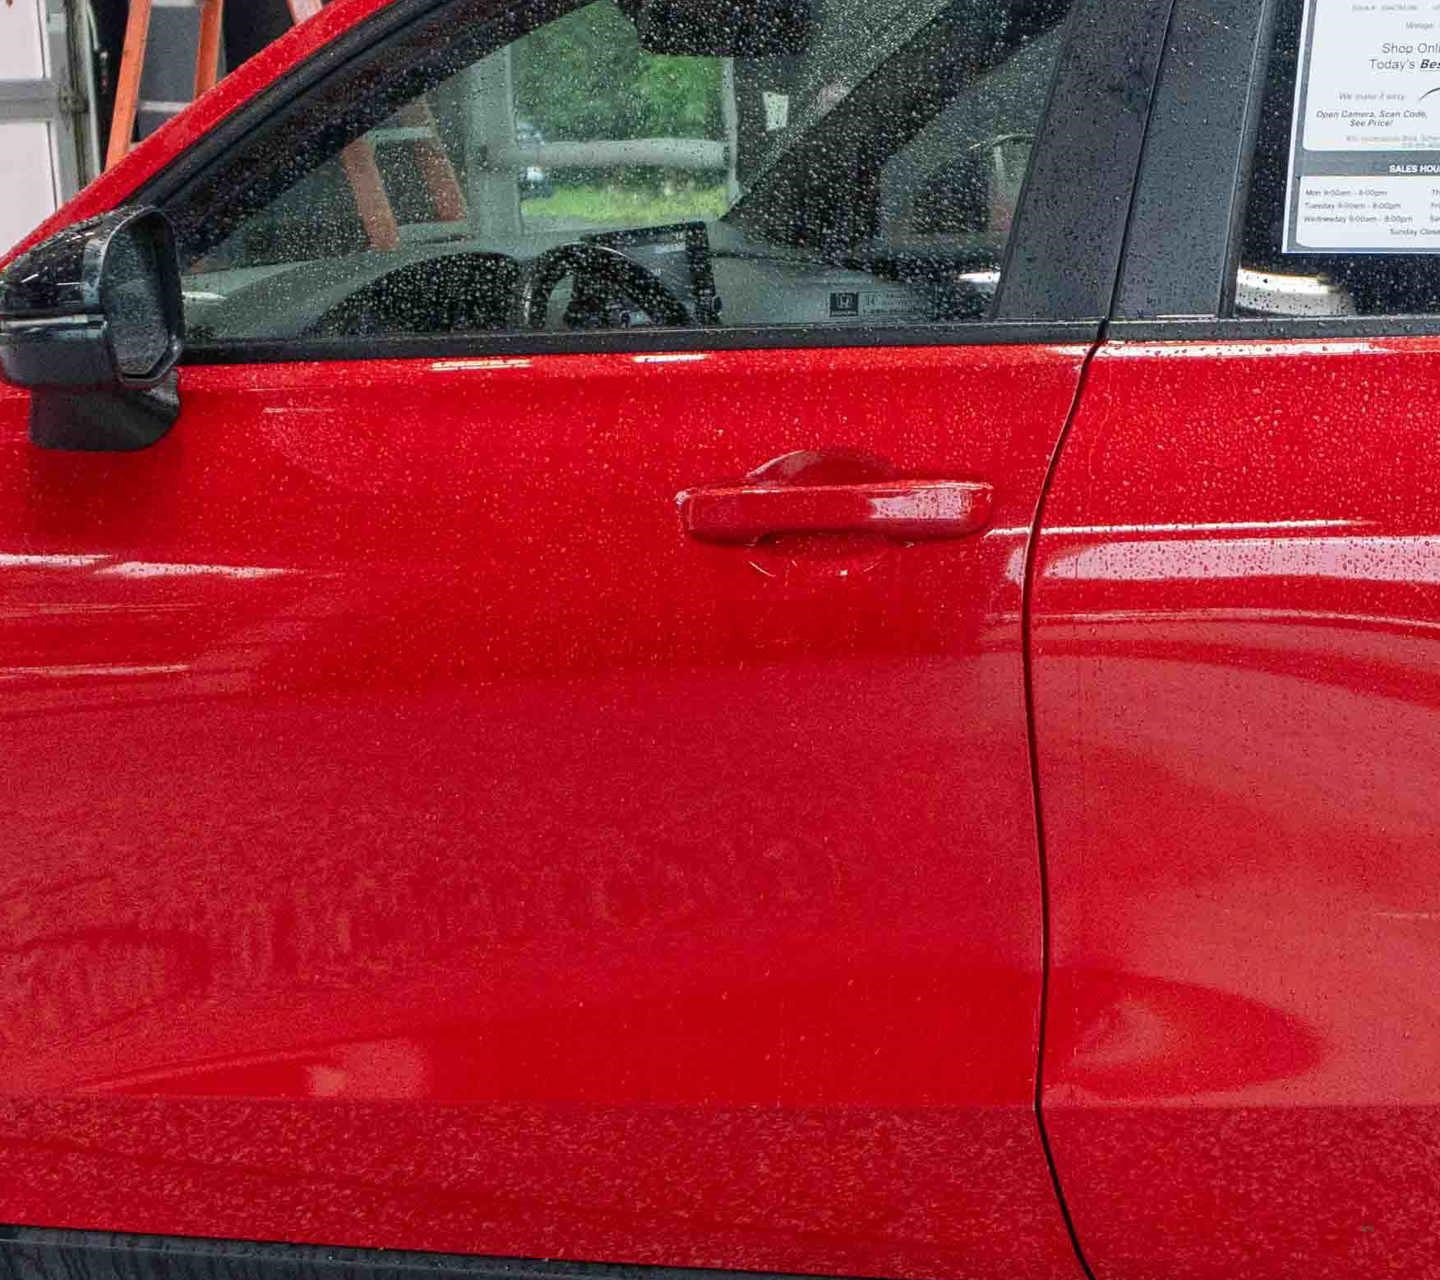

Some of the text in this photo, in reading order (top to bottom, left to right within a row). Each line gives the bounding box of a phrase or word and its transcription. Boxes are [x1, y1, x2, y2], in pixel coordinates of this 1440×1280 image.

[1382, 42, 1414, 55] Shop
[1369, 58, 1416, 72] Today's
[1316, 109, 1428, 120] Open Camera, Scan Code,
[1349, 119, 1366, 127] See
[1388, 164, 1418, 173] SALES
[1390, 228, 1417, 237] Sunday
